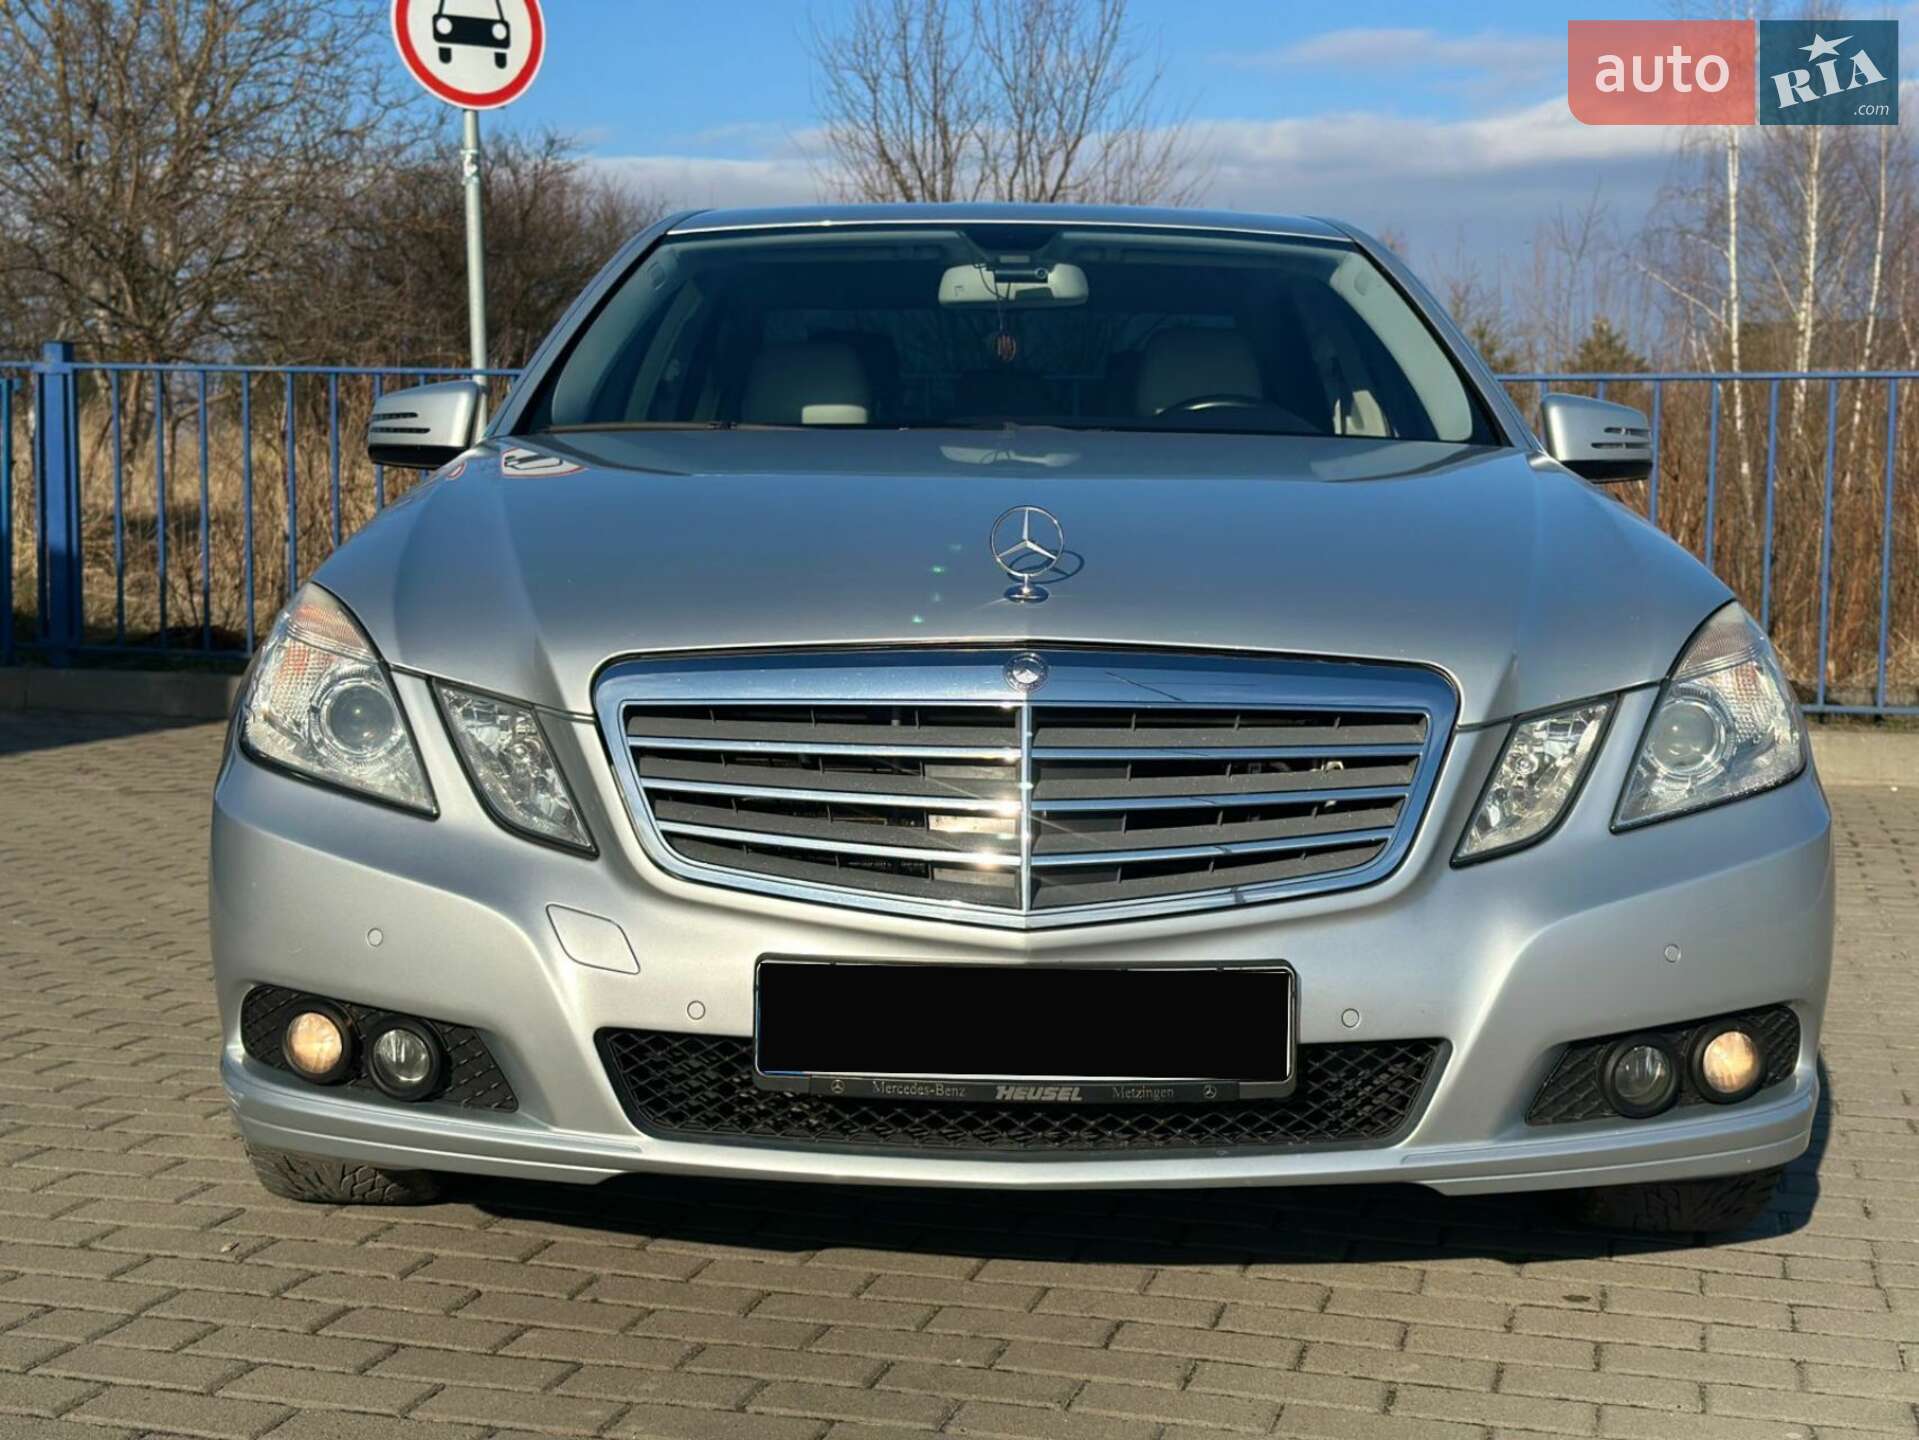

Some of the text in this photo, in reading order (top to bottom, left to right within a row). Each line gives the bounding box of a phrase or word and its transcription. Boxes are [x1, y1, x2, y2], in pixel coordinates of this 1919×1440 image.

[872, 1080, 1174, 1102] Mercedes-Benz HEUSEL Metzingen
